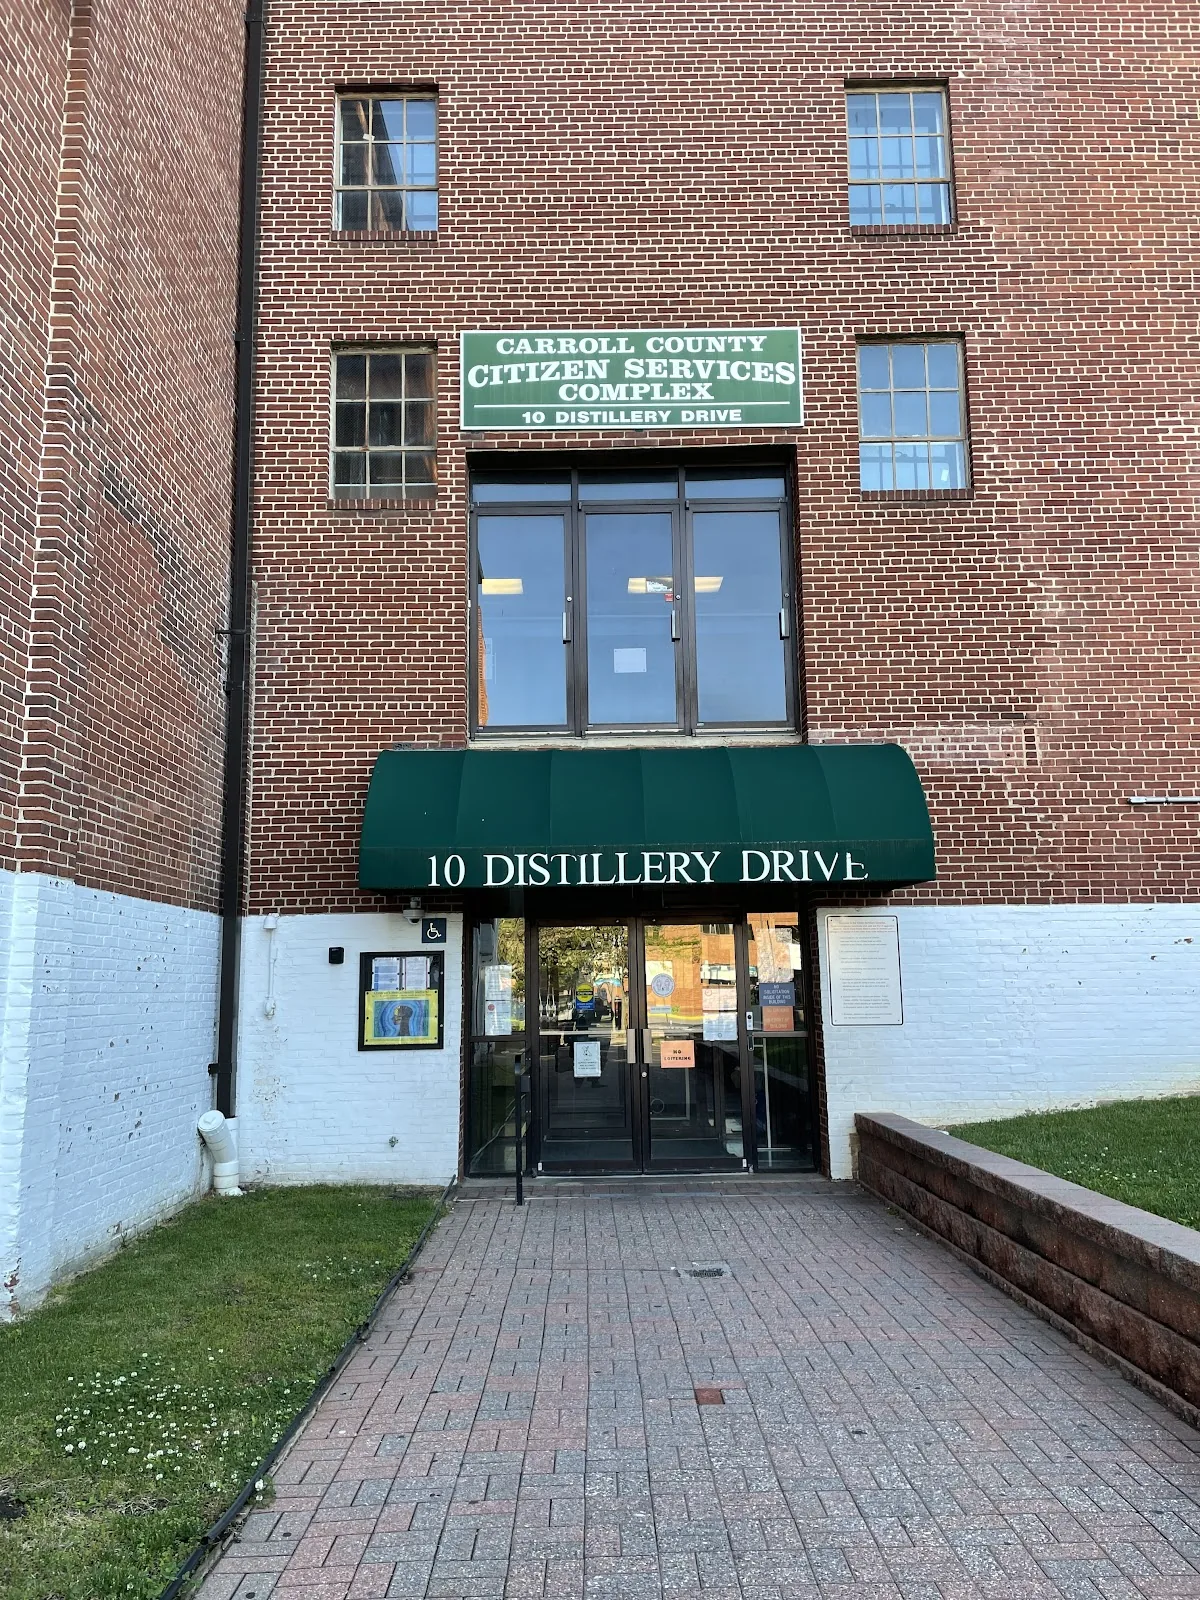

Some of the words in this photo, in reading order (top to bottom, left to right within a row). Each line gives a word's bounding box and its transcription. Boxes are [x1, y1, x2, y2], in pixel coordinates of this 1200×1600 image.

[496, 337, 635, 355] CARROLL
[645, 335, 768, 353] COUNTY
[467, 358, 610, 388] CITIZEN
[624, 358, 796, 385] SERVICES
[558, 382, 715, 401] COMPLEX
[521, 411, 546, 424] 10
[555, 410, 672, 423] DISTILLERY
[681, 409, 742, 422] DRIVE
[427, 854, 466, 887] 10
[482, 850, 722, 887] DISTILLERY
[738, 849, 869, 882] DRIVE
